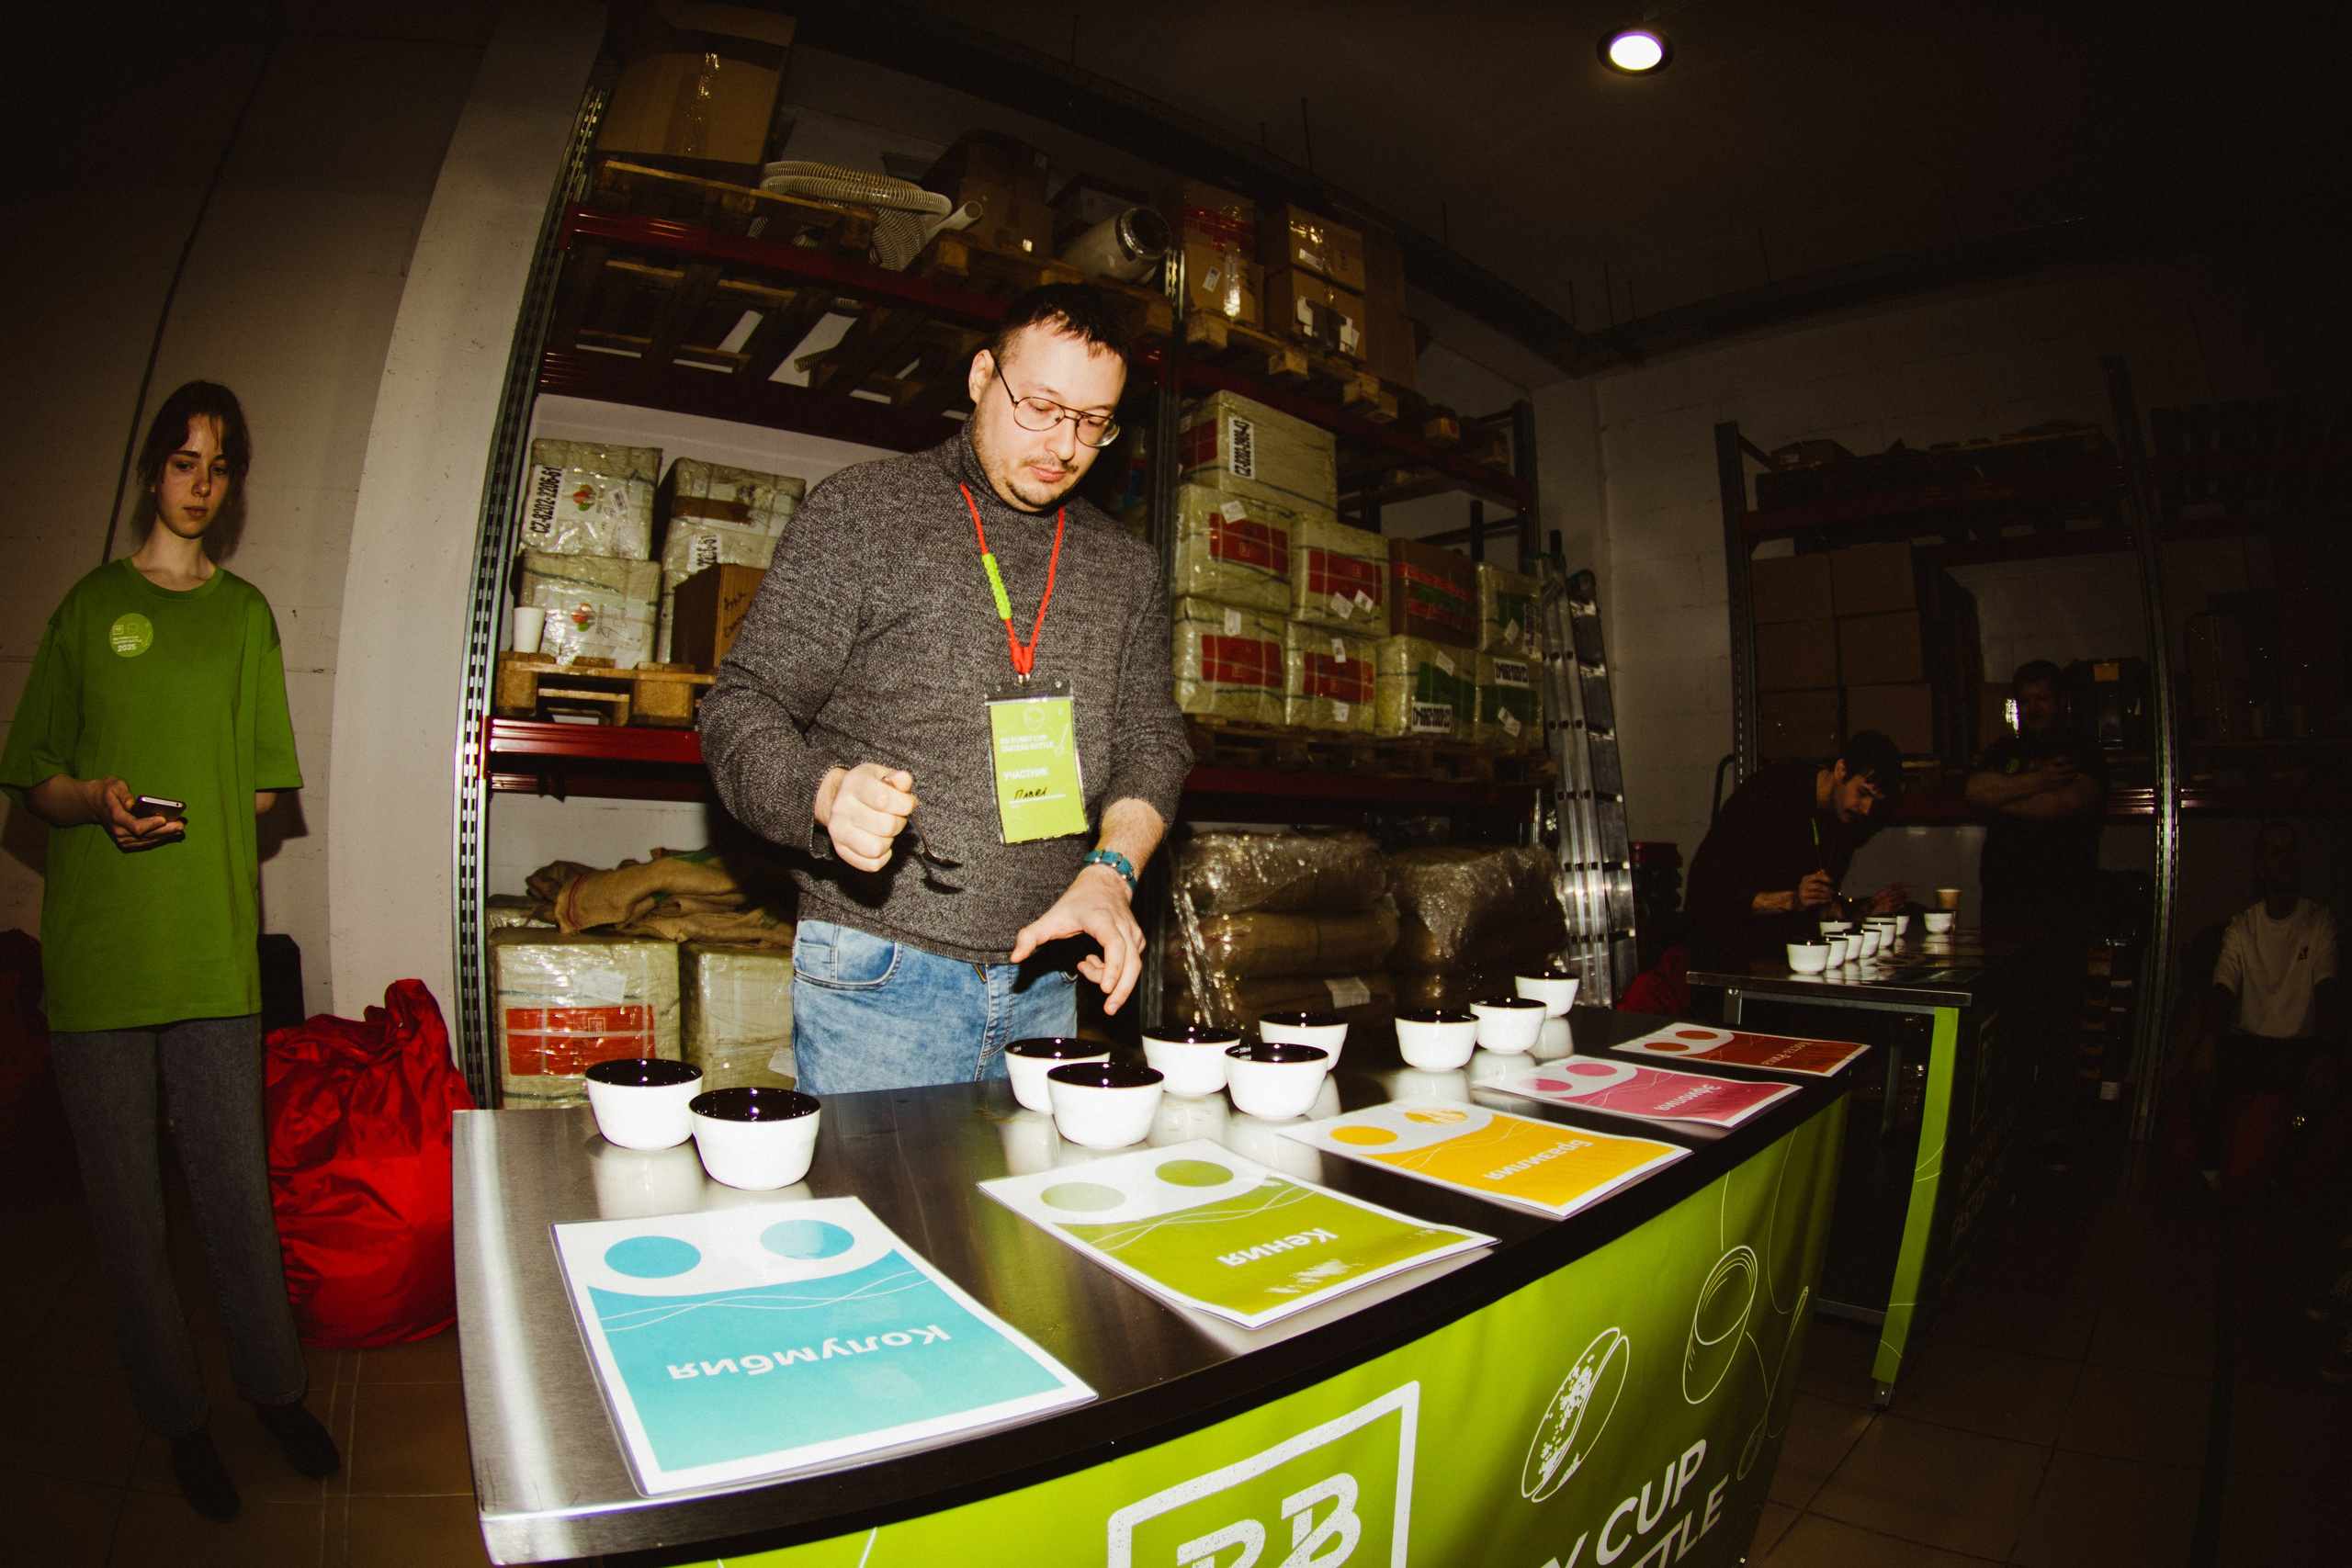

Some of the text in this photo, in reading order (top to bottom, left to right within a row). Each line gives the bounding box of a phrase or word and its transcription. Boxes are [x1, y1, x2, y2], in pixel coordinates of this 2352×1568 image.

[1001, 740, 1054, 752] TASTERS BATTLE
[1011, 735, 1032, 743] FUNKY
[1003, 766, 1049, 781] УЧАСТНИК
[1654, 1084, 1722, 1111] Эфиопия
[1482, 1139, 1594, 1180] Бразилия
[1216, 1227, 1339, 1267] Кения
[666, 1325, 952, 1380] Колумбия
[1596, 1438, 1706, 1565] CUP
